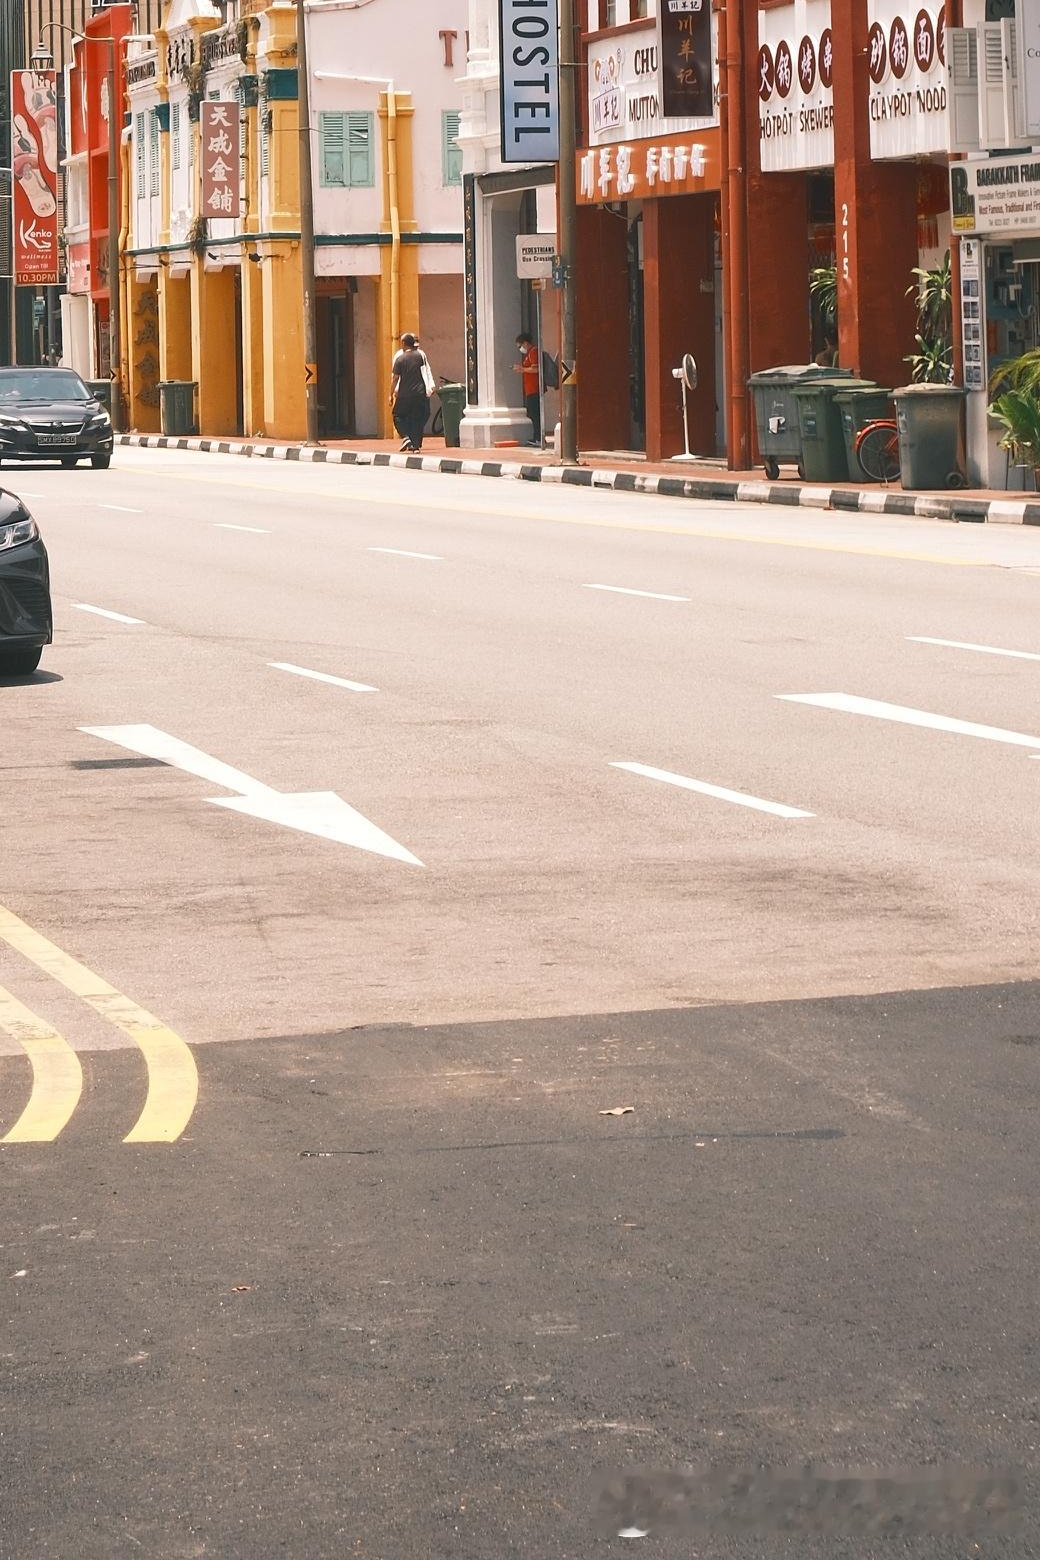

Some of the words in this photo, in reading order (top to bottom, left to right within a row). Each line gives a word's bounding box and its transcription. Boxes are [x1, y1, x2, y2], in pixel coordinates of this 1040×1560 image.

[871, 91, 912, 121] CLAYPOT
[760, 112, 793, 139] HOTPOT
[20, 219, 52, 249] Kenko
[841, 203, 849, 280] 215
[18, 273, 56, 283] 10.30PM
